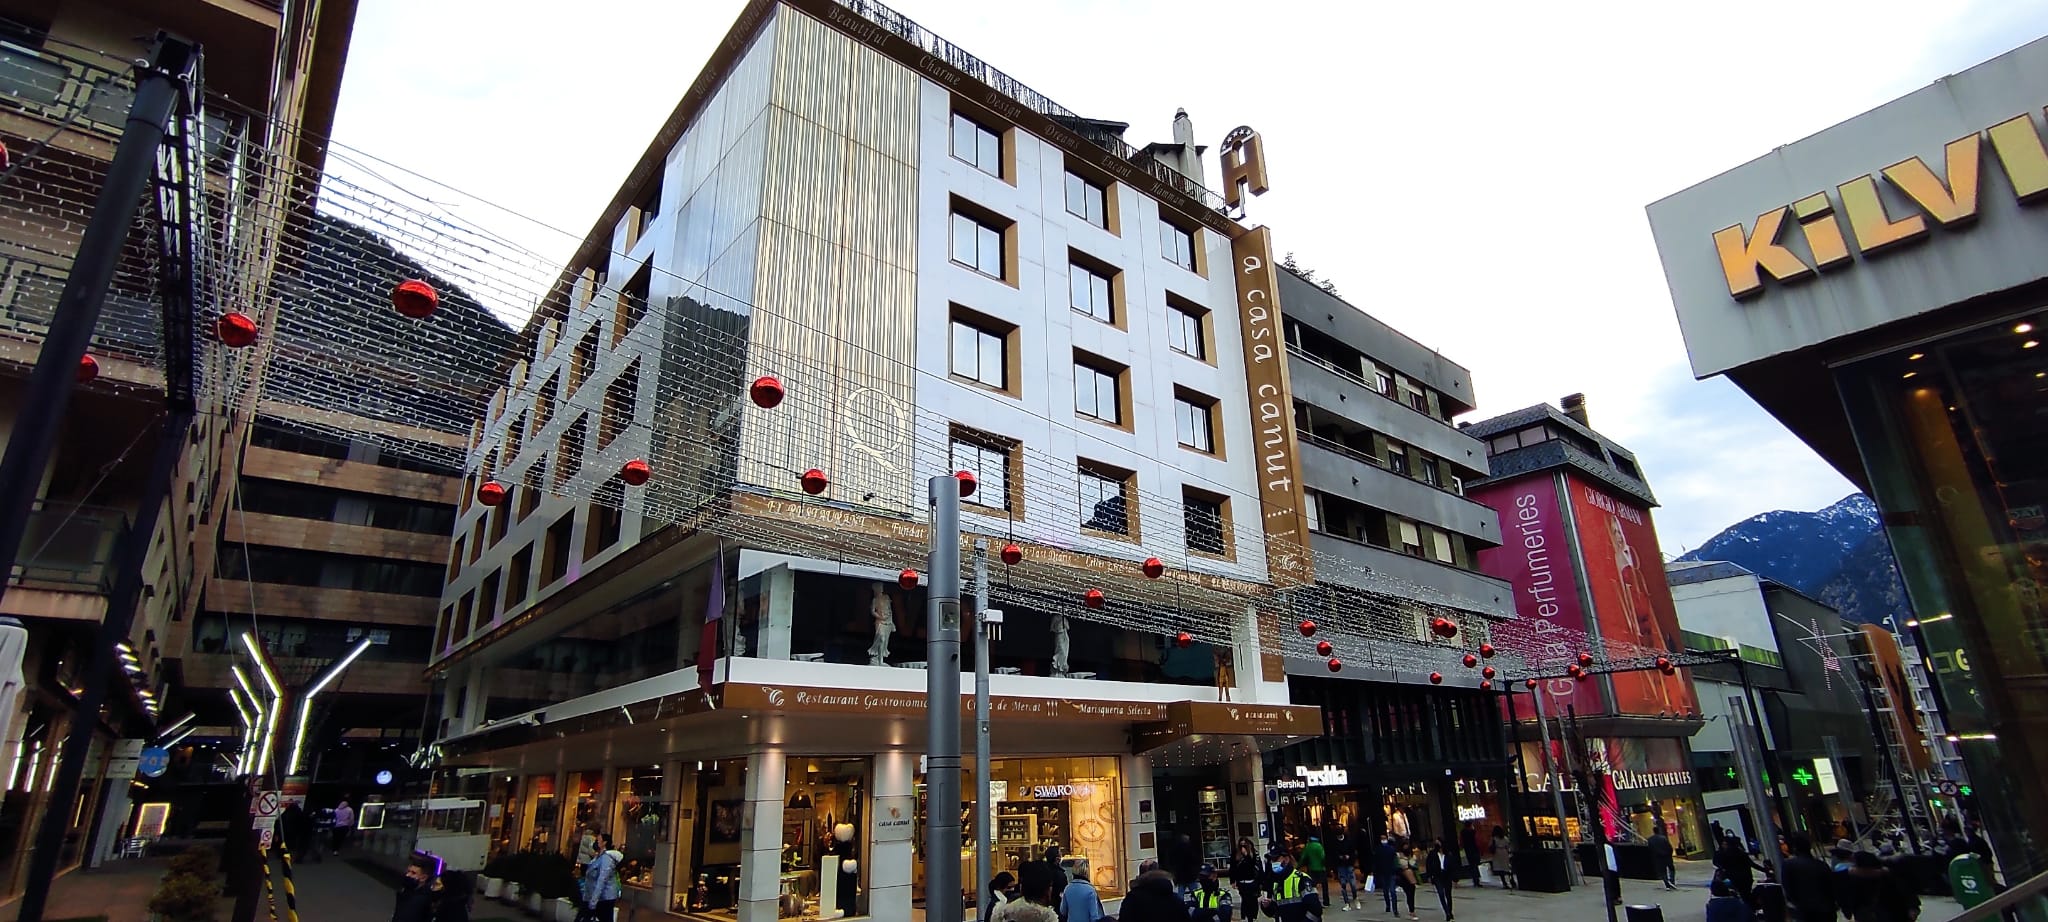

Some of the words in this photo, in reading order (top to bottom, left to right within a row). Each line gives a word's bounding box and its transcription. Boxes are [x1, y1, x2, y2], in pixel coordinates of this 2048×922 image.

[826, 4, 893, 48] Beautiful
[919, 55, 962, 87] Charme
[986, 90, 1023, 119] Design
[1043, 124, 1081, 151] Dreams
[1100, 155, 1132, 179] Encant
[1150, 181, 1187, 208] Hammam
[1712, 104, 2048, 302] KiLVI
[1241, 255, 1262, 276] a
[1245, 287, 1273, 365] casa
[1258, 383, 1292, 492] canut
[1584, 486, 1617, 515] GIORGIO
[1616, 500, 1642, 527] ARMANI
[1515, 493, 1563, 635] Perfumeries
[796, 691, 859, 706] Restaurant
[997, 698, 1008, 711] de
[1012, 699, 1041, 713] Mercat
[1127, 704, 1152, 717] Selecta
[1277, 779, 1306, 789] Bershka
[1612, 769, 1638, 790] GALA
[1638, 770, 1692, 789] PERFUMERIES
[1457, 804, 1487, 822] Bershka
[1259, 822, 1267, 837] P
